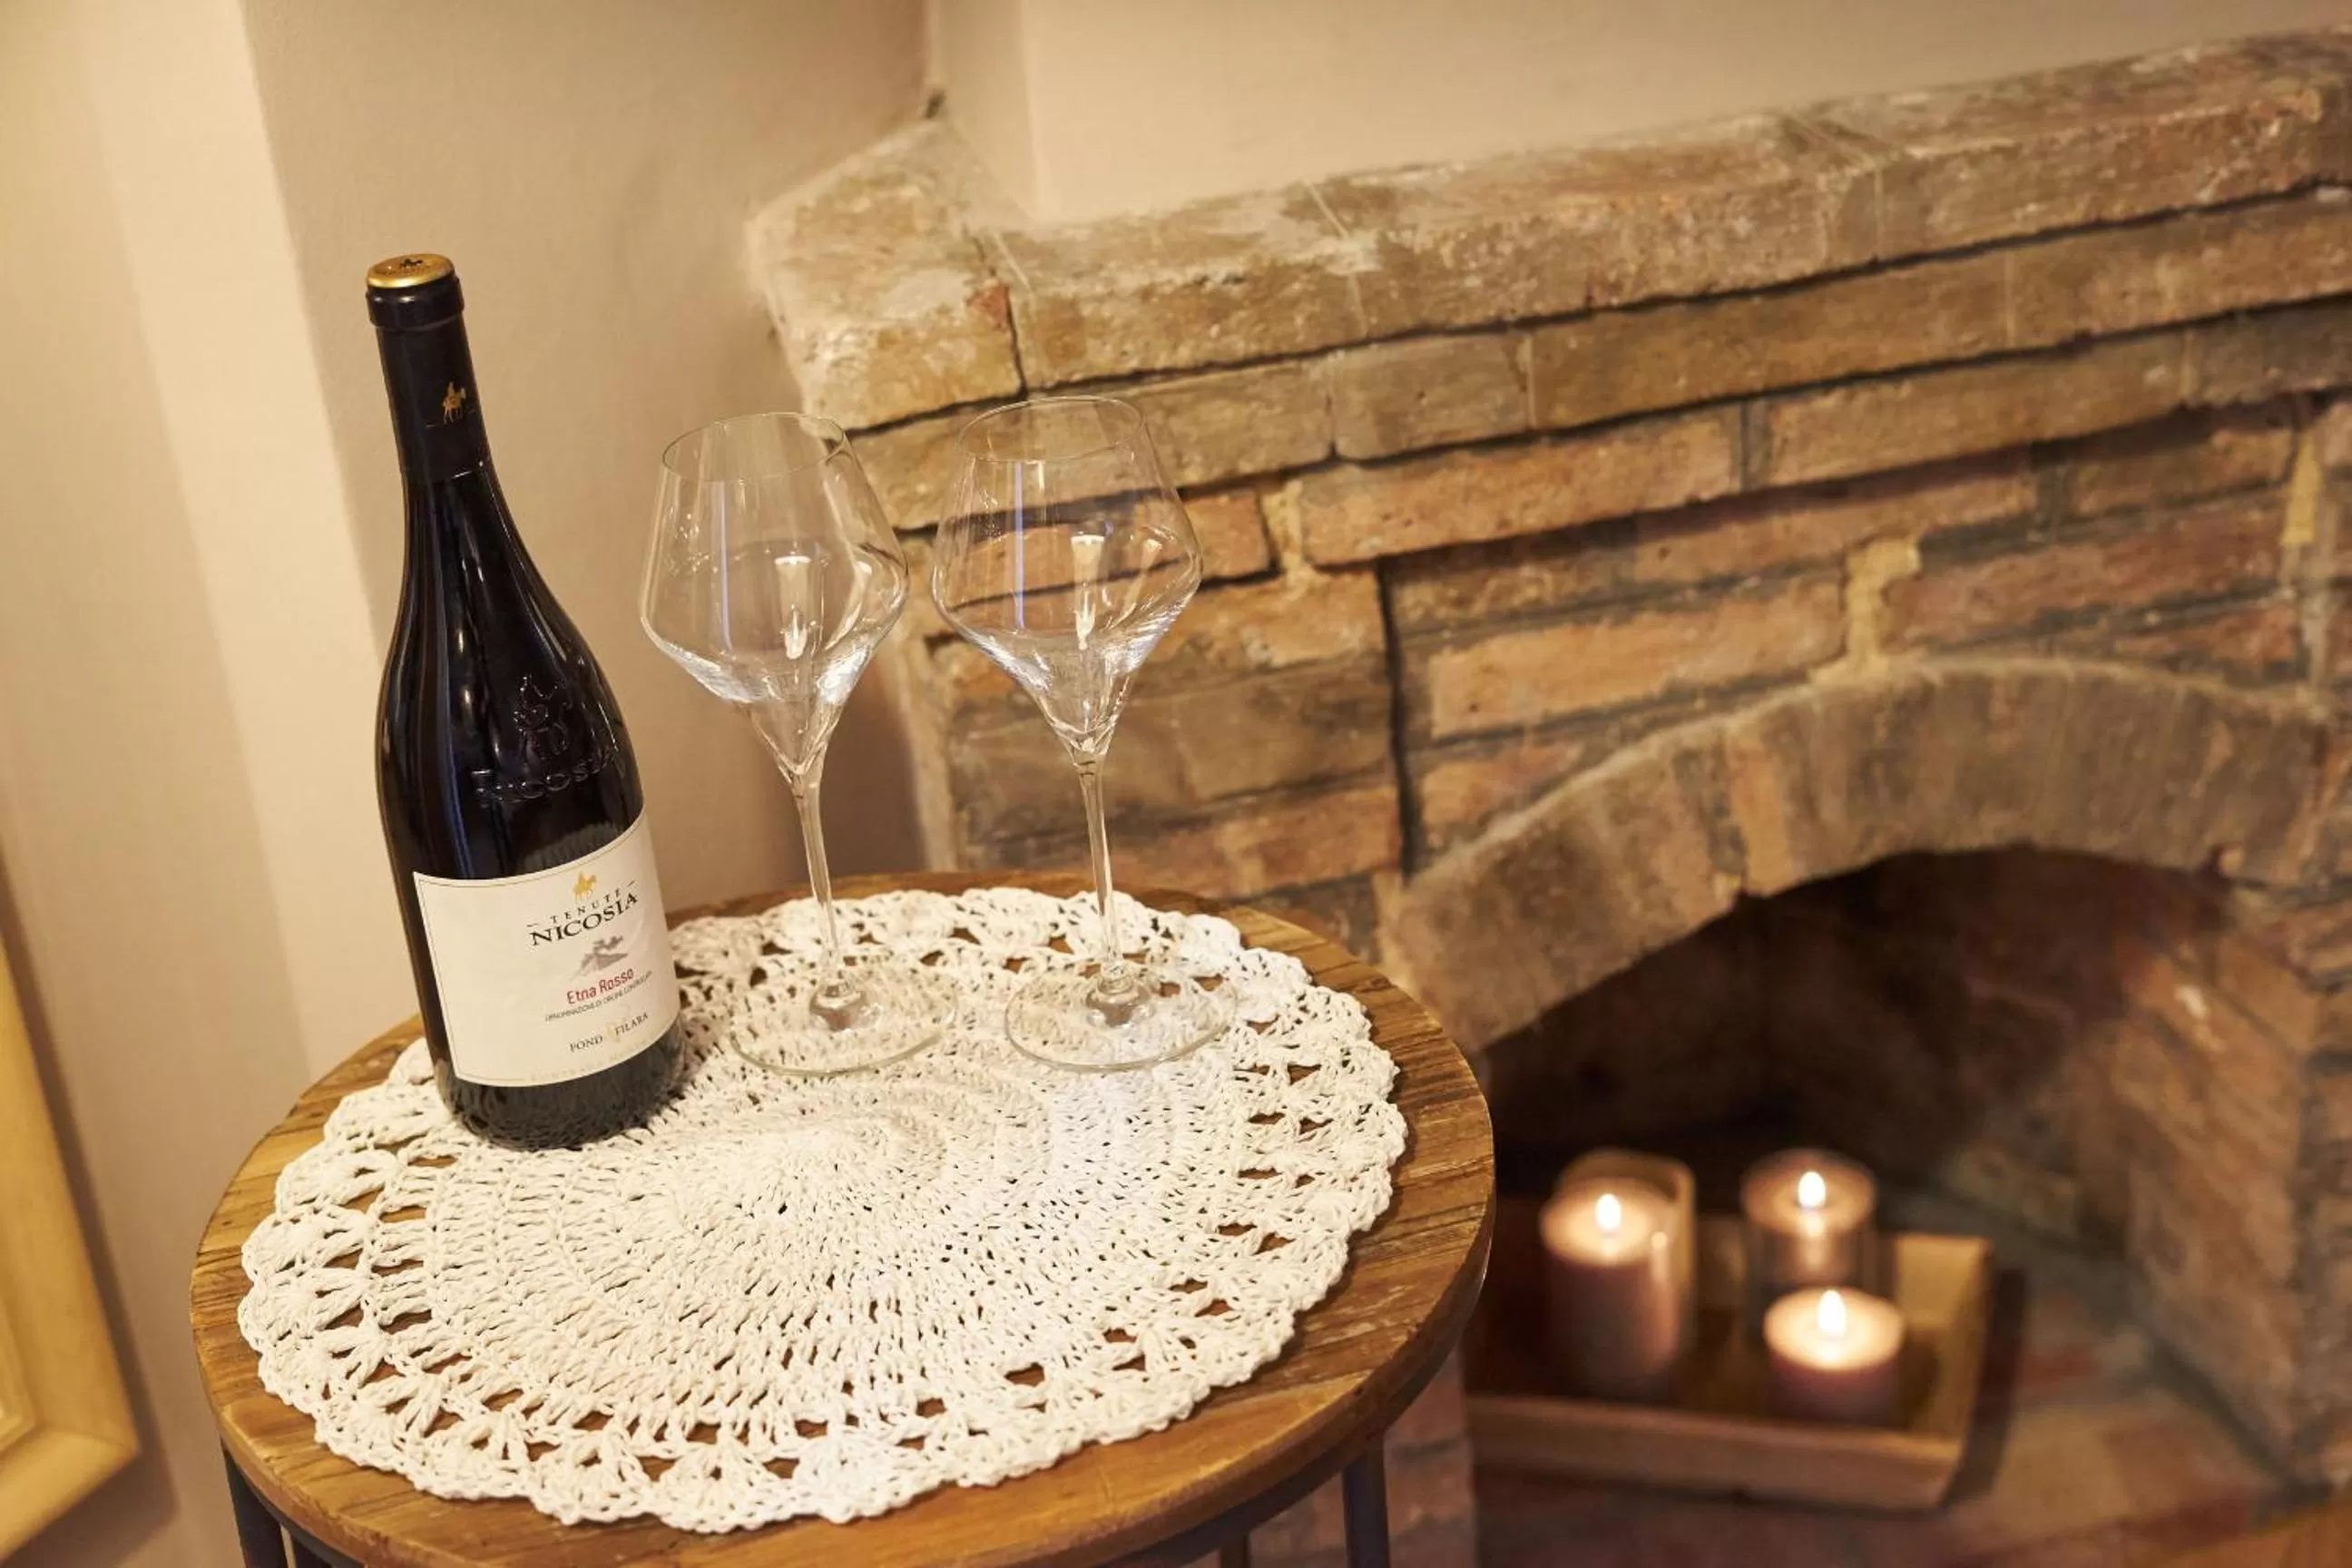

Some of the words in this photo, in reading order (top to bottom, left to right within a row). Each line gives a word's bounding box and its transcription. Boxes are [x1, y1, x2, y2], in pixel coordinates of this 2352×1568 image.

[529, 892, 638, 946] NICOSIA
[550, 888, 621, 924] TENUTE
[566, 985, 597, 1004] Etna
[598, 968, 634, 994] Rosso
[614, 1012, 649, 1036] FILARA
